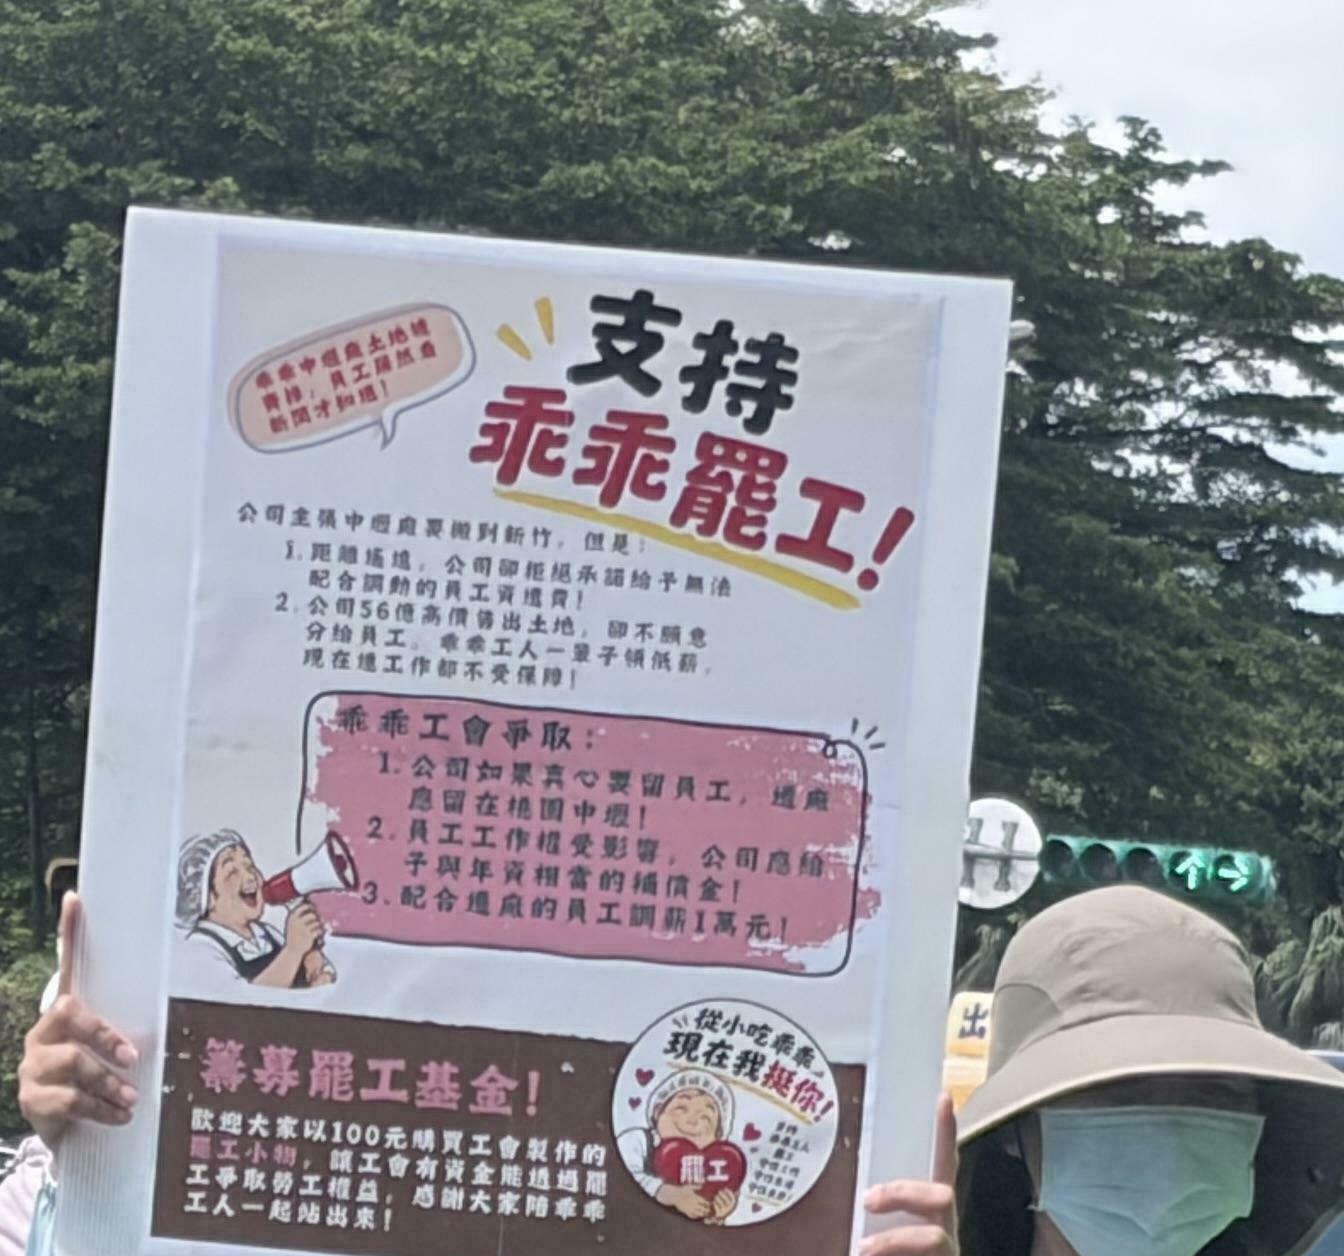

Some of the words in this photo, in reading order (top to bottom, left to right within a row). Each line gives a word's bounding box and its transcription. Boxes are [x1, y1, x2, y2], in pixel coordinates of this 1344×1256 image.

[567, 289, 799, 435] 支持
[468, 385, 915, 591] 乖乖罷工！
[680, 1154, 729, 1184] 罷工
